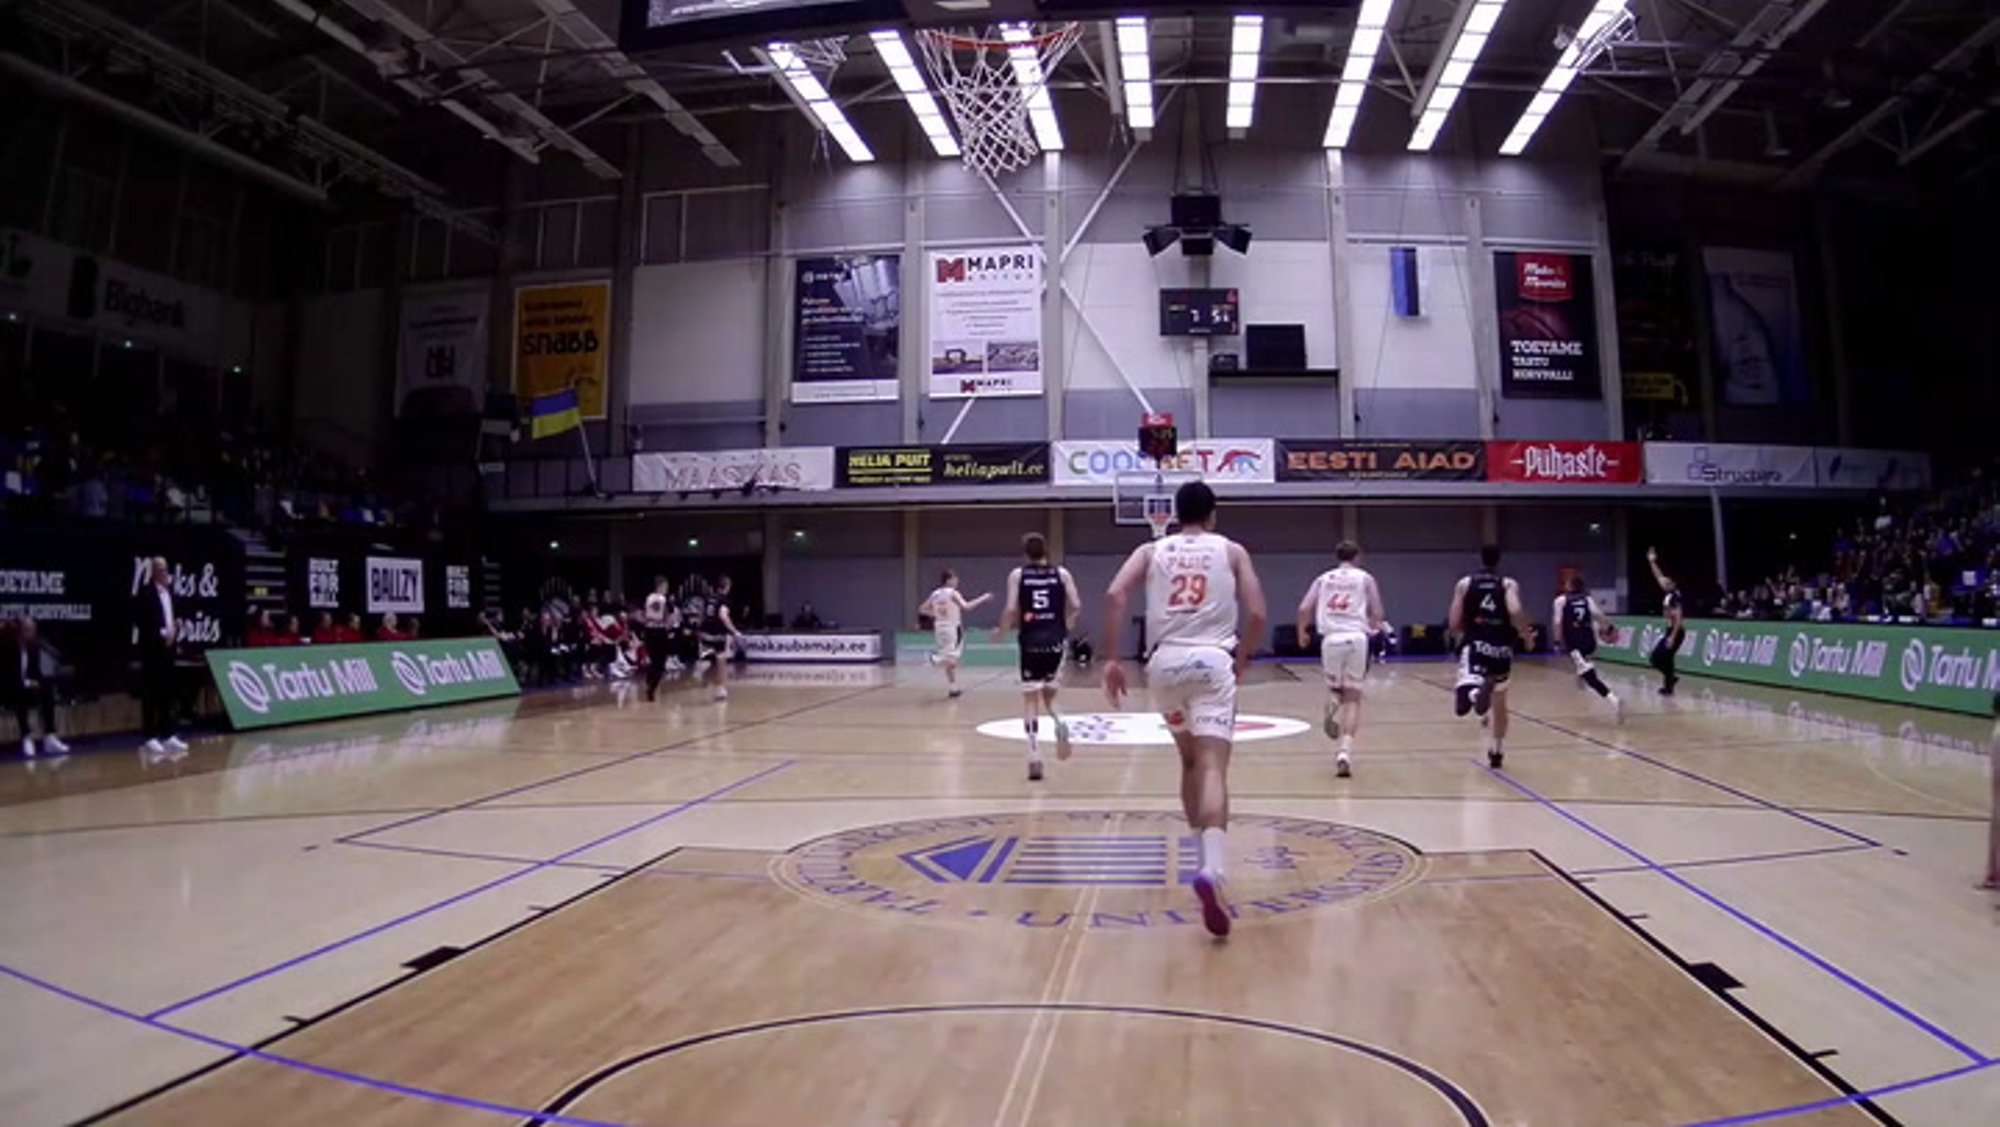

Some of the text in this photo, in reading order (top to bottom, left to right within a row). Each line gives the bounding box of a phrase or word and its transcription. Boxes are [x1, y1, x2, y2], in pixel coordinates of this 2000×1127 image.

[968, 254, 1033, 271] MAPRI
[1511, 340, 1583, 355] TOETAME
[1512, 356, 1550, 367] TARTU
[895, 453, 931, 467] PUIT
[1287, 451, 1475, 470] EESTI AIAD
[0, 570, 65, 594] OETAME
[132, 556, 219, 597] Mks &
[1032, 590, 1050, 609] 5
[1168, 574, 1207, 606] 29
[1479, 592, 1497, 612] 4
[416, 649, 506, 686] Tartu Mill
[1810, 638, 1888, 678] Tartu Mill
[1928, 646, 1983, 689] Tartu
[262, 657, 379, 700] Tartu Mill
